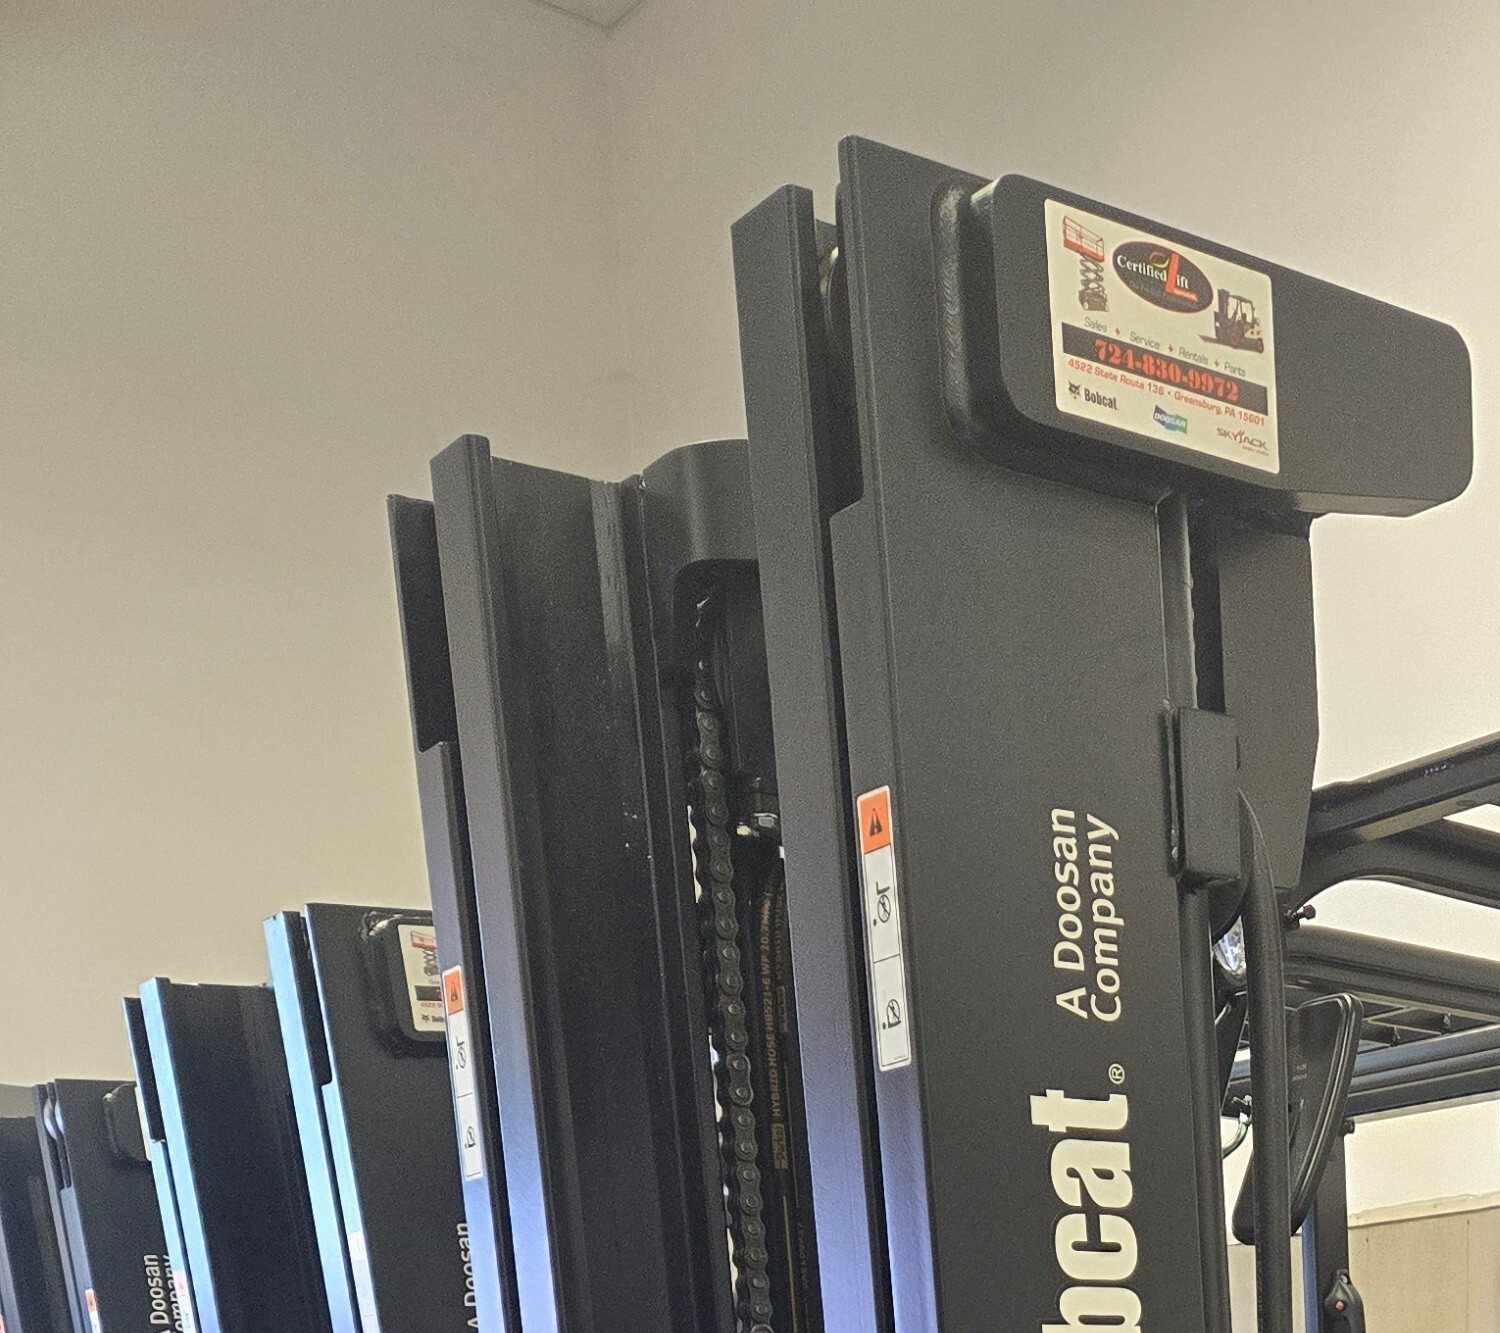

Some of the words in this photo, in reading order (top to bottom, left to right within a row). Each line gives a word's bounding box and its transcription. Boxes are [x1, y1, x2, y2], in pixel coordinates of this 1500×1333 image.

[1117, 254, 1167, 281] Certified
[1084, 316, 1107, 332] Sales
[1129, 331, 1160, 349] Service
[1179, 347, 1208, 365] Rentals
[1224, 362, 1246, 377] Parts
[1095, 338, 1238, 402] 724-830-9972
[1068, 358, 1092, 373] 4522
[1094, 366, 1118, 381] State
[1120, 374, 1144, 389] Route
[1224, 406, 1235, 418] PA
[1238, 411, 1265, 427] 15601
[1083, 387, 1117, 410] Bobcat
[1051, 808, 1085, 971] Doosan
[1087, 813, 1125, 1022] Company
[1055, 986, 1089, 1020] A
[144, 1254, 170, 1325] Doosan
